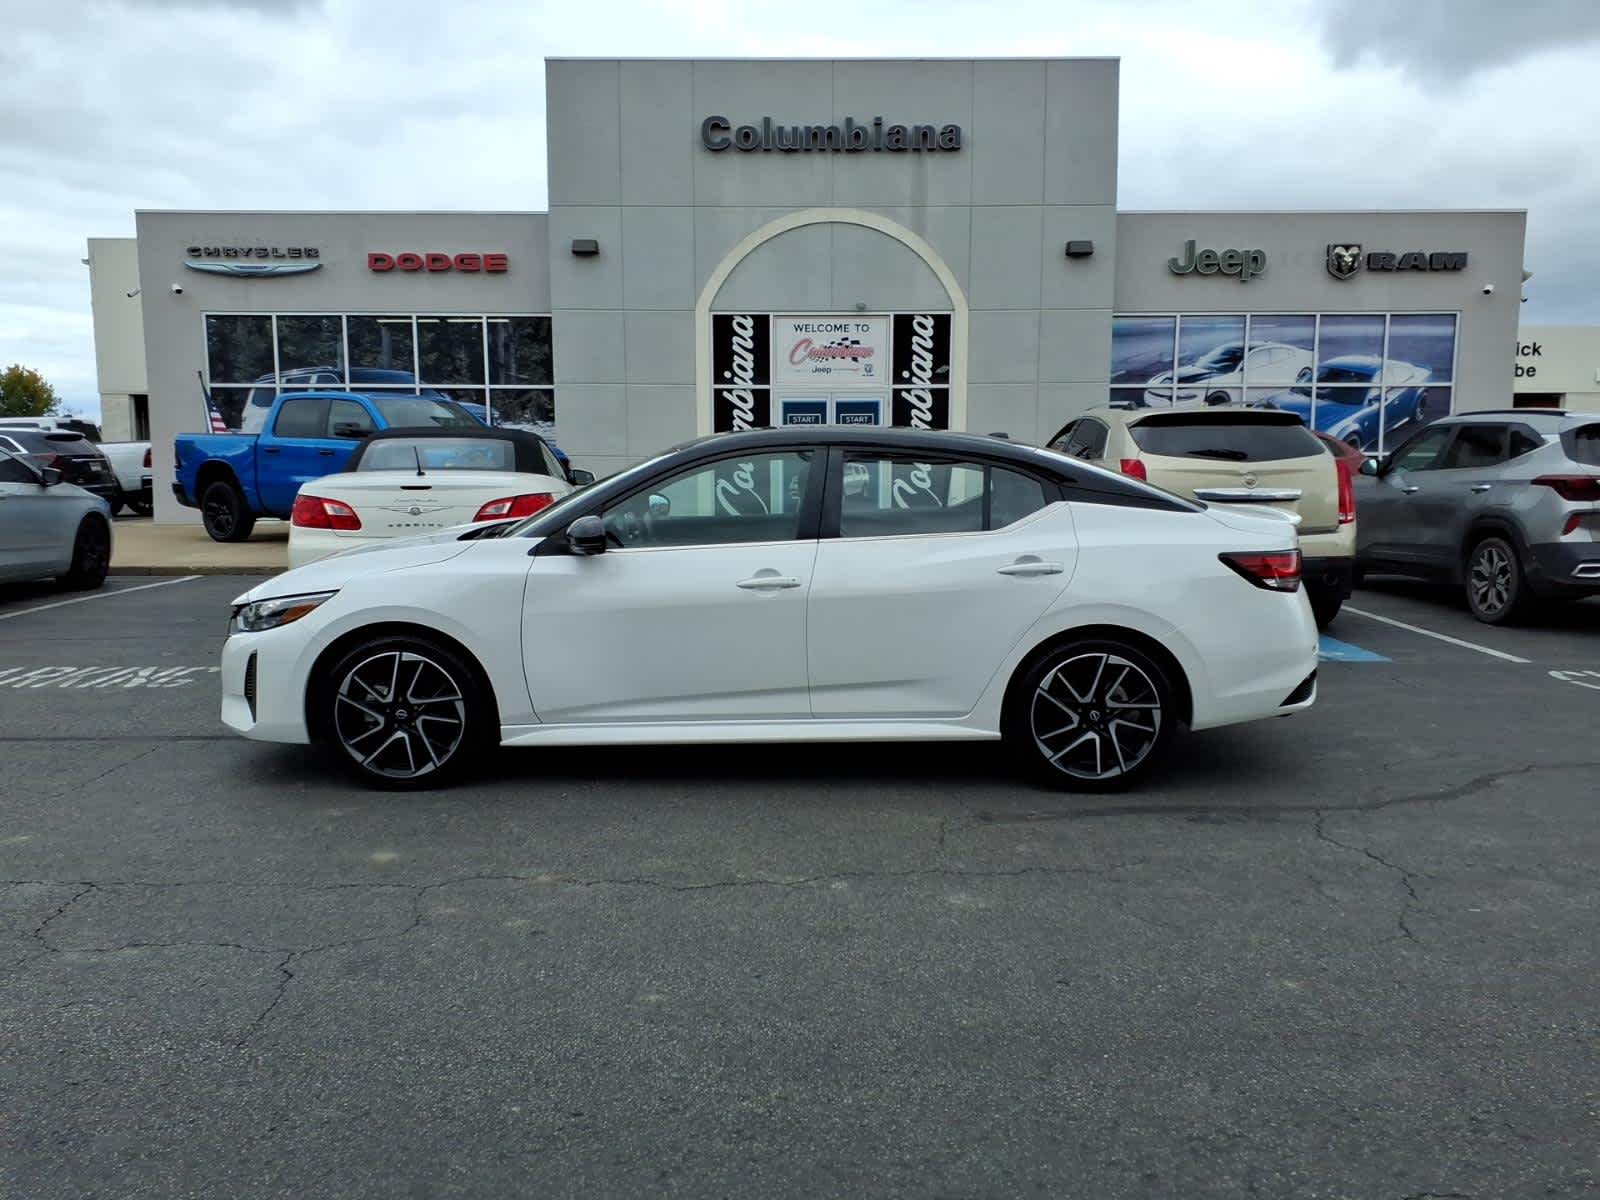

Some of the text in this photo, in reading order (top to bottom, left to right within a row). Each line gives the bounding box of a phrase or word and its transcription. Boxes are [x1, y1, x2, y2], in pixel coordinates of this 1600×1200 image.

[702, 115, 962, 152] Columbiana
[186, 246, 320, 258] CHRYSLER
[367, 252, 508, 272] DODGE
[1167, 239, 1267, 281] Jeep
[1367, 251, 1468, 272] RAM
[793, 323, 870, 333] WELCOME TO
[1515, 341, 1542, 356] ick
[1514, 363, 1537, 377] be
[792, 416, 816, 424] START
[845, 416, 868, 424] START
